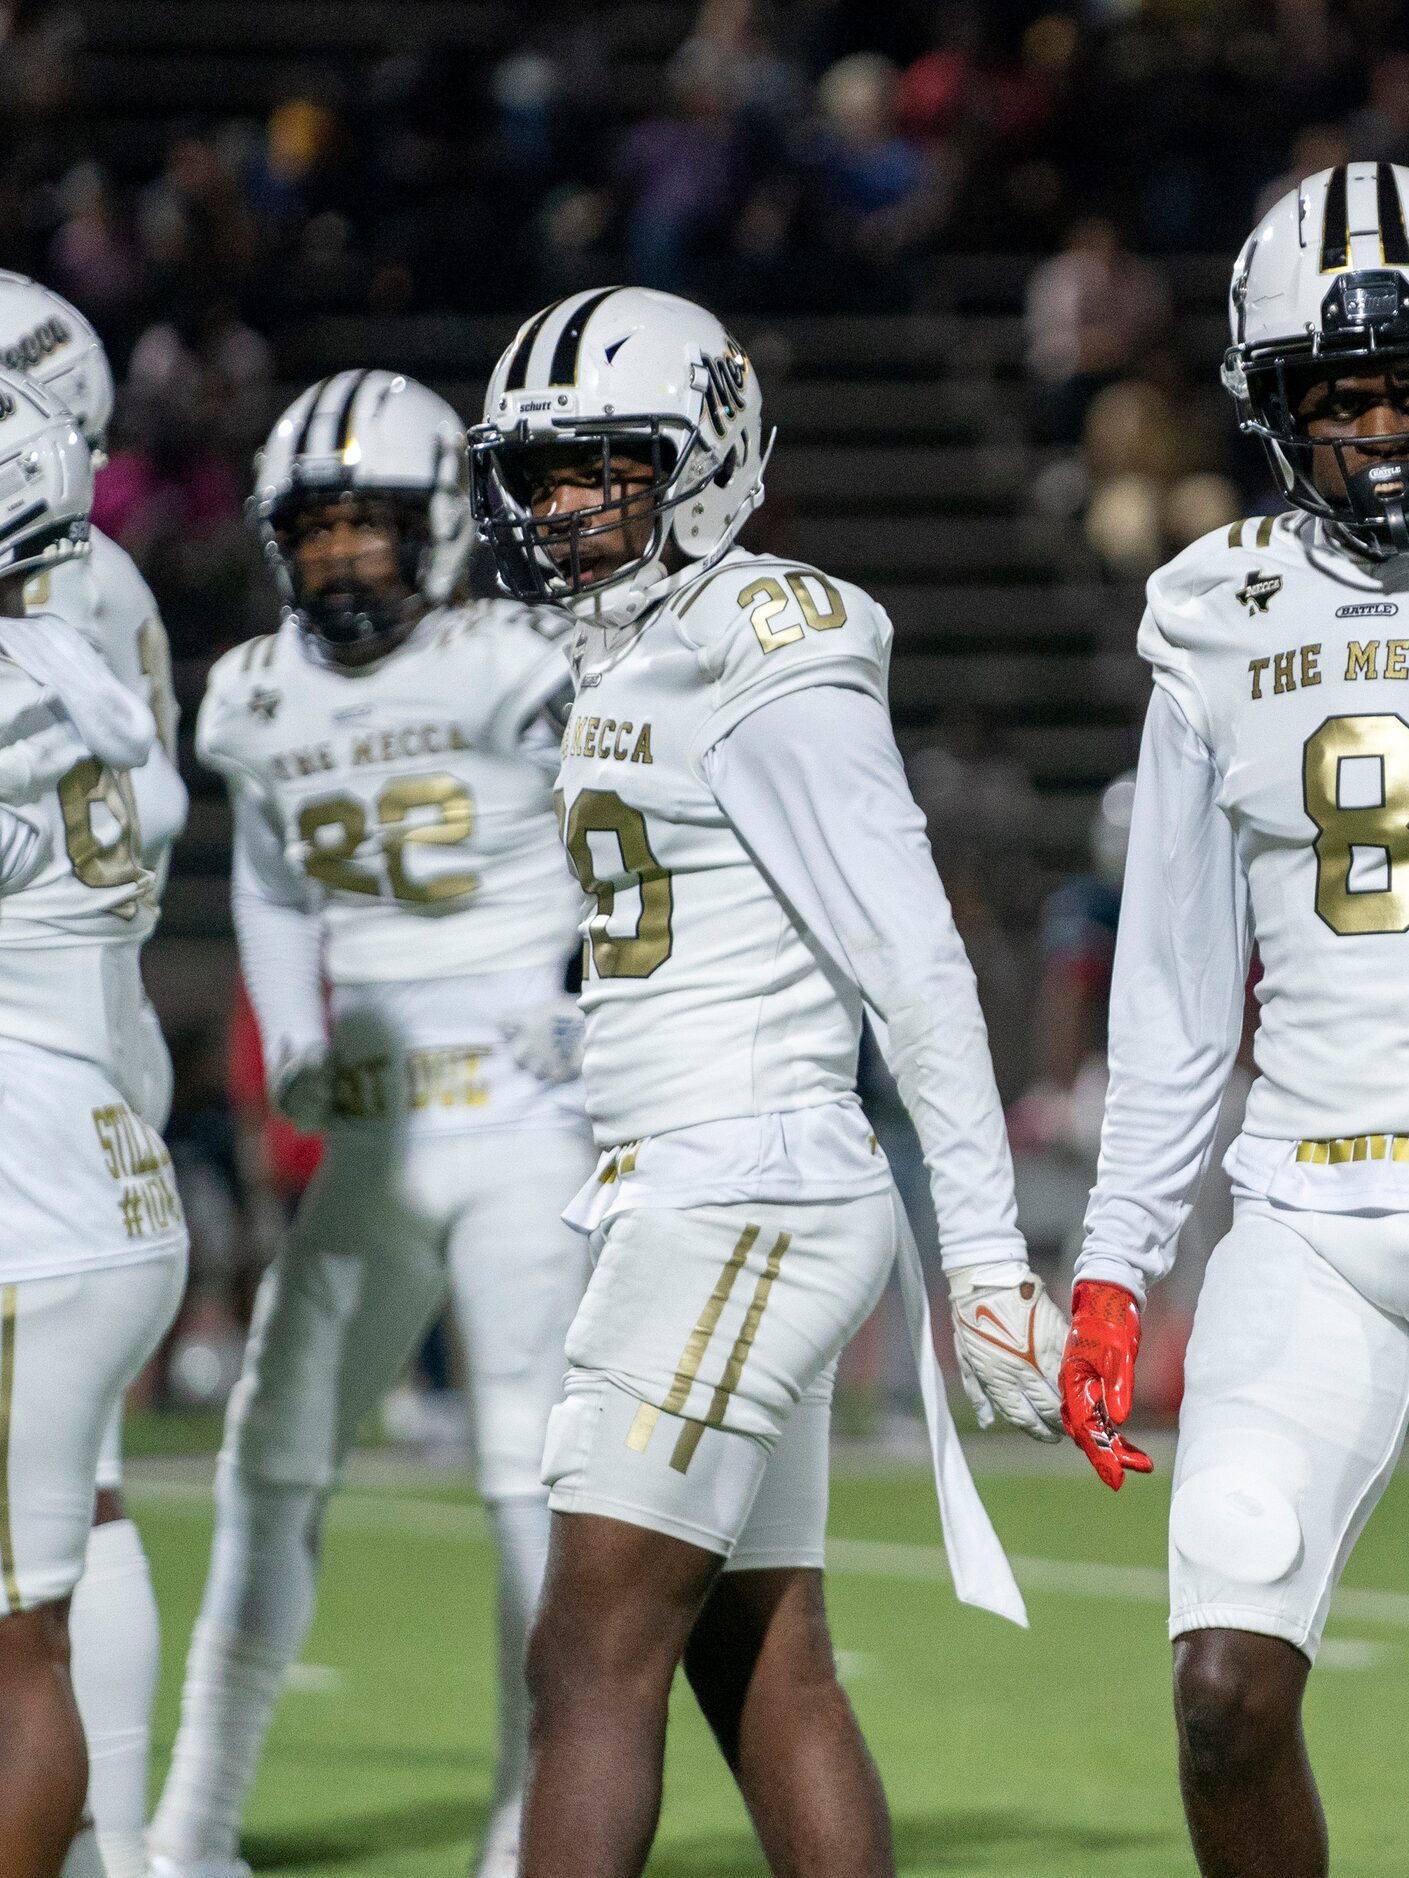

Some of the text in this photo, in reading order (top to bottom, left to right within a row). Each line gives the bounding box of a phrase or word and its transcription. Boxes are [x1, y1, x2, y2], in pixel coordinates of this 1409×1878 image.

[519, 400, 552, 413] schutt
[736, 569, 848, 656] 20
[1340, 603, 1393, 616] BATTLE
[1248, 643, 1322, 700] THE
[352, 719, 474, 766] MECCA
